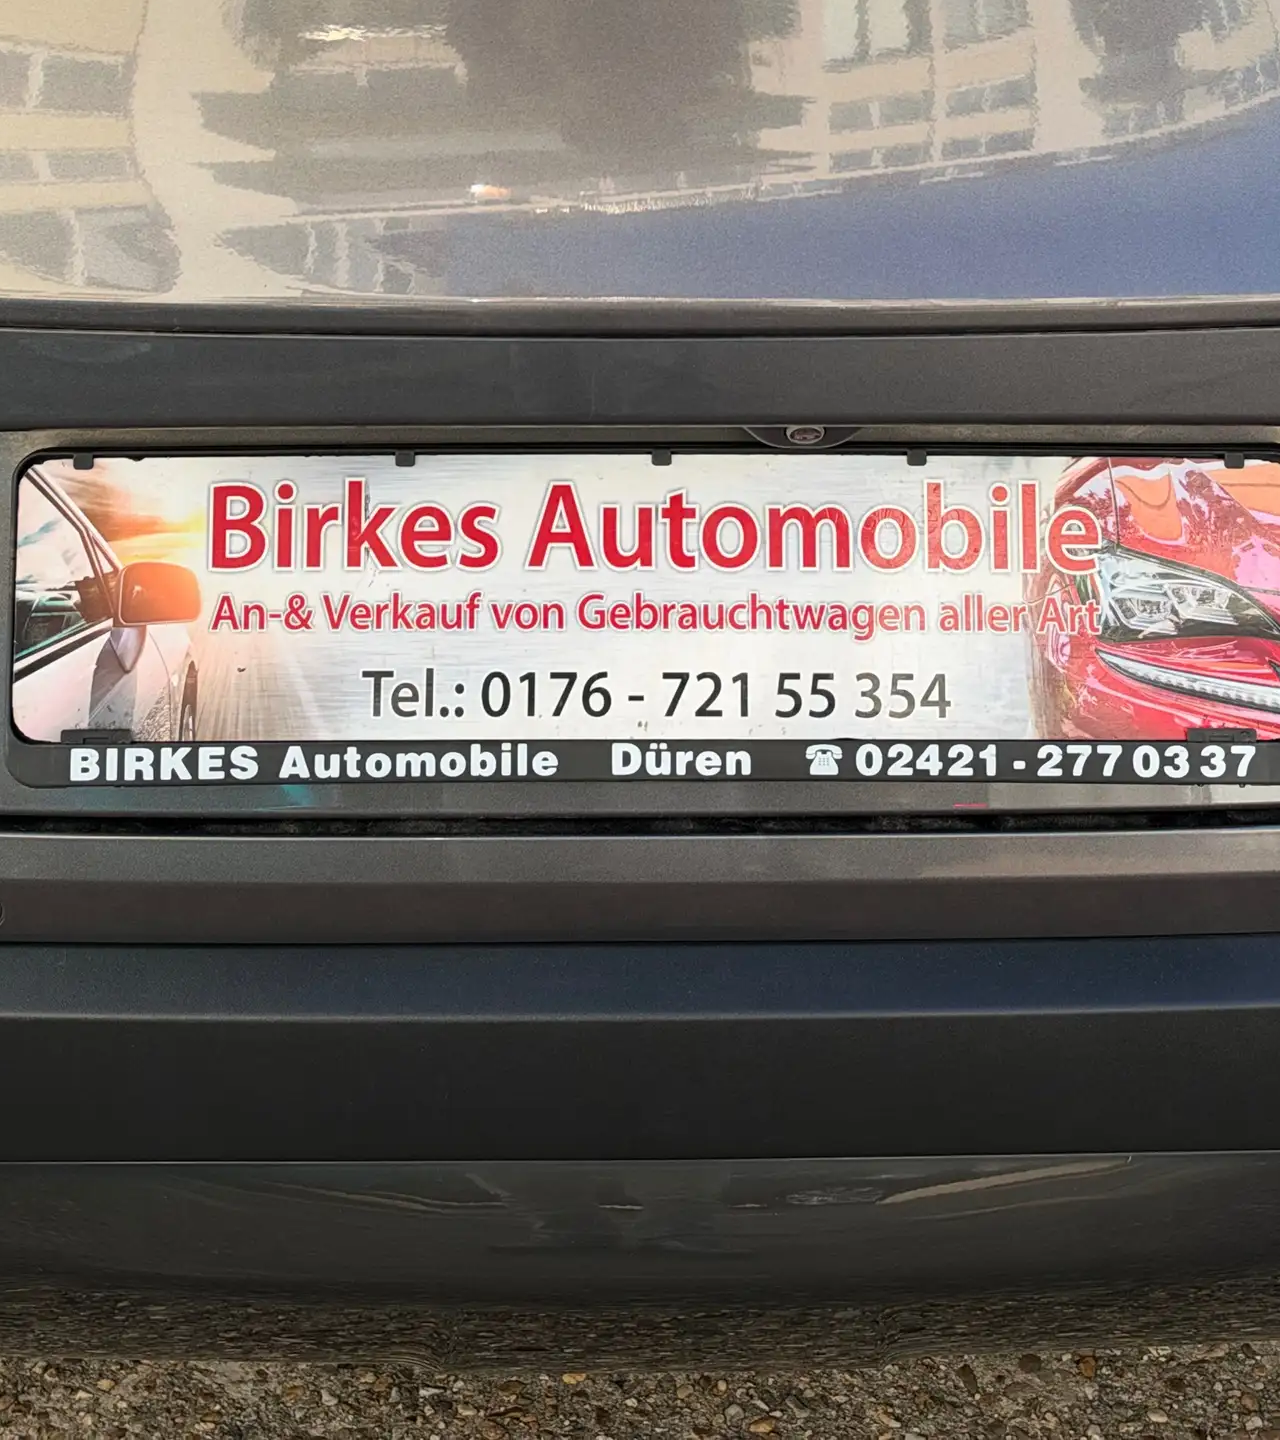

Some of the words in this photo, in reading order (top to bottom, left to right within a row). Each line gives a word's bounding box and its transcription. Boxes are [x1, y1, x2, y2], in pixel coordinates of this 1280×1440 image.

[209, 478, 502, 572] Birkes
[525, 479, 1104, 574] Automobile
[321, 592, 482, 631] Verkauf
[491, 601, 565, 631] von
[578, 593, 926, 642] Gebrauchtwagen
[940, 594, 1028, 633] aller
[1037, 596, 1102, 635] Art
[361, 670, 466, 718] Tel.:
[480, 671, 613, 718] 0176
[662, 672, 750, 718] 721
[774, 672, 837, 718] 55
[854, 672, 952, 719] 354
[69, 745, 259, 782] BIRKES
[278, 744, 560, 780] Automobile
[611, 742, 752, 777] Düren
[855, 743, 998, 777] 02421
